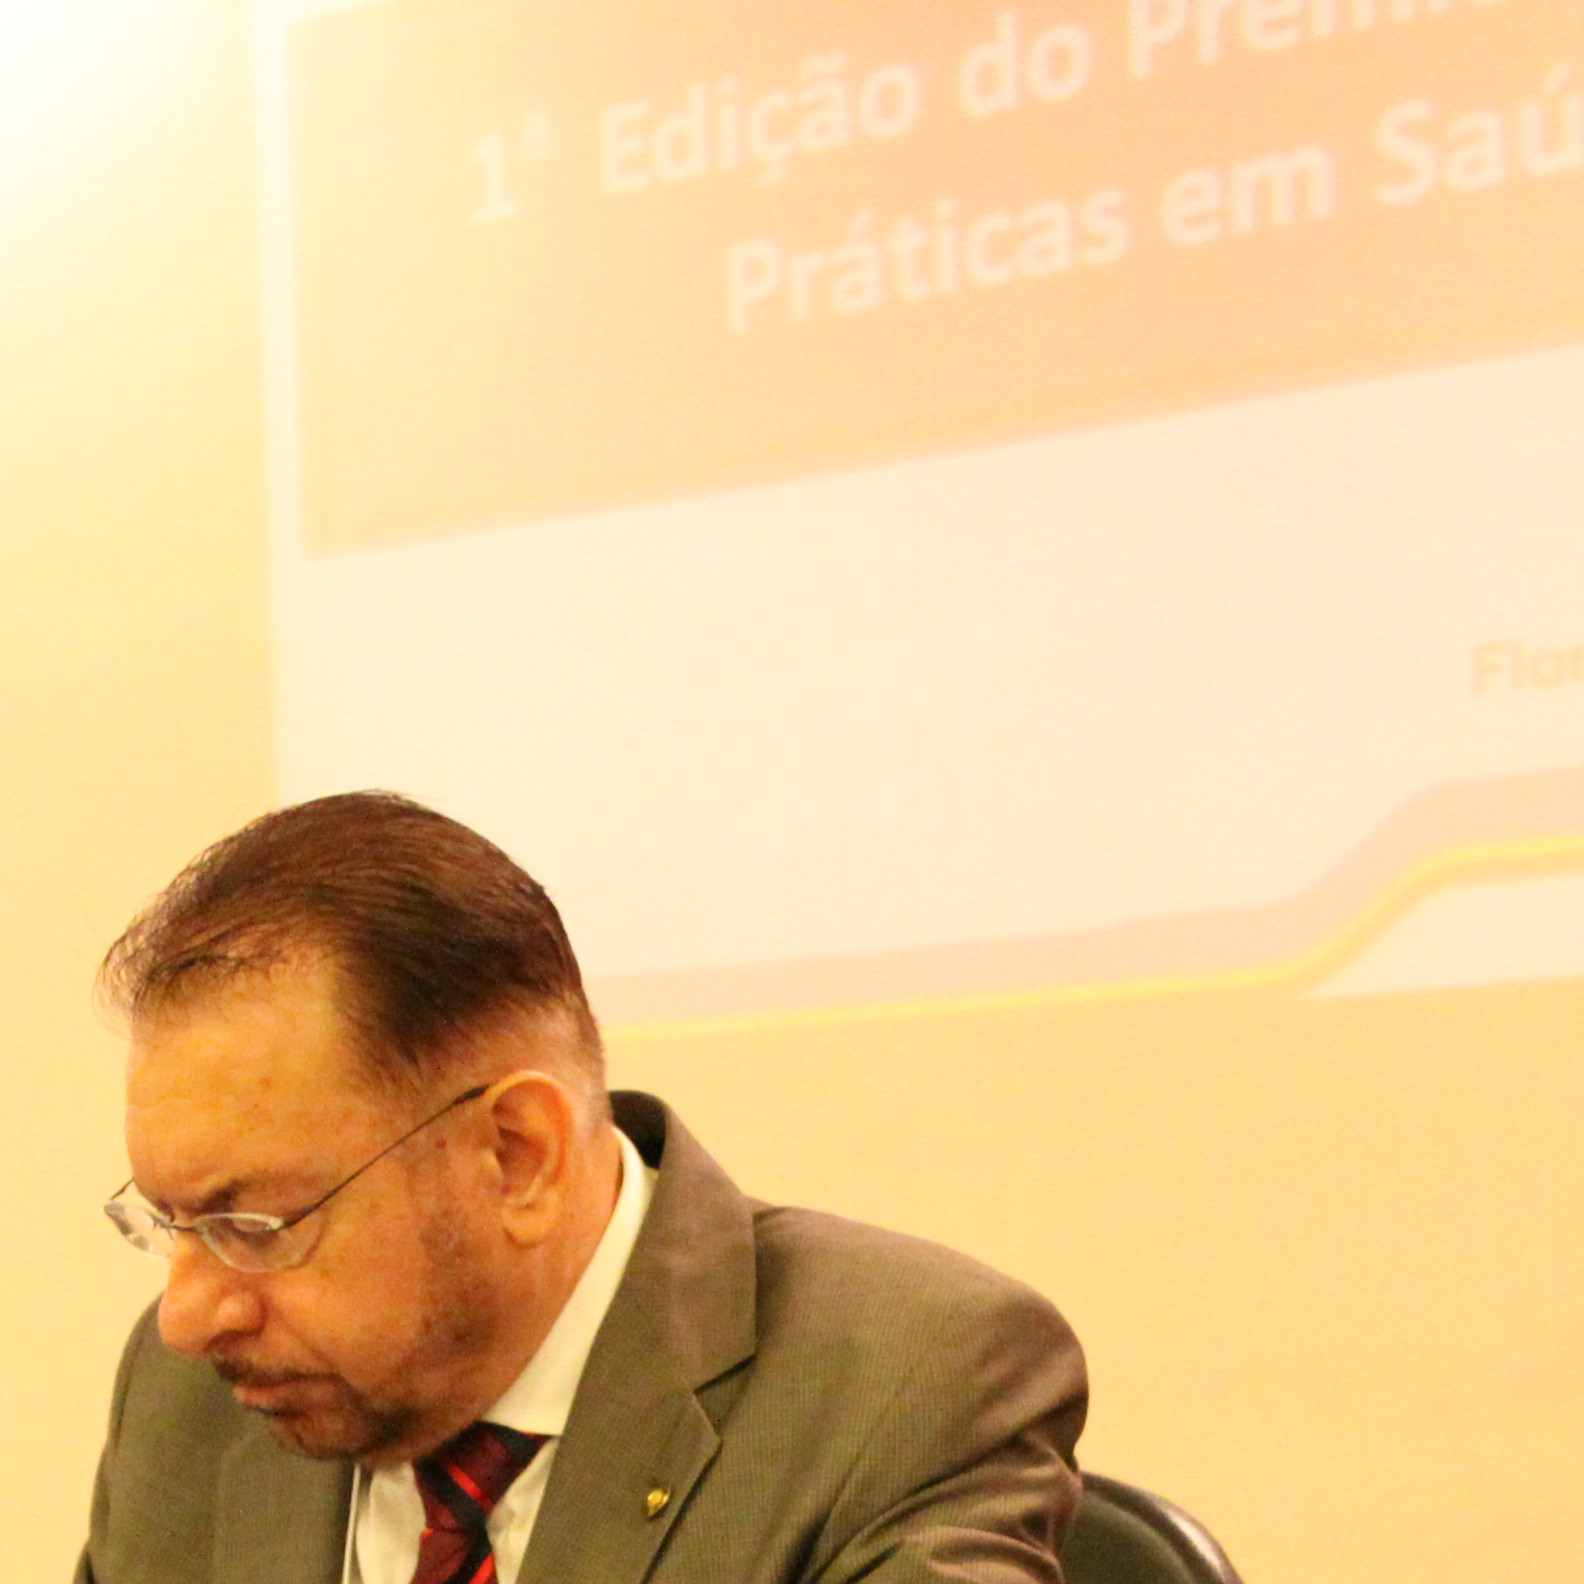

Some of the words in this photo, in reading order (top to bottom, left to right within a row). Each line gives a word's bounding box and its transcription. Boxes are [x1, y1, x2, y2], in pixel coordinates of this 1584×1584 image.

[598, 50, 924, 194] Edição
[957, 8, 1094, 121] do
[724, 188, 1130, 335] Práticas
[1160, 144, 1336, 247] em
